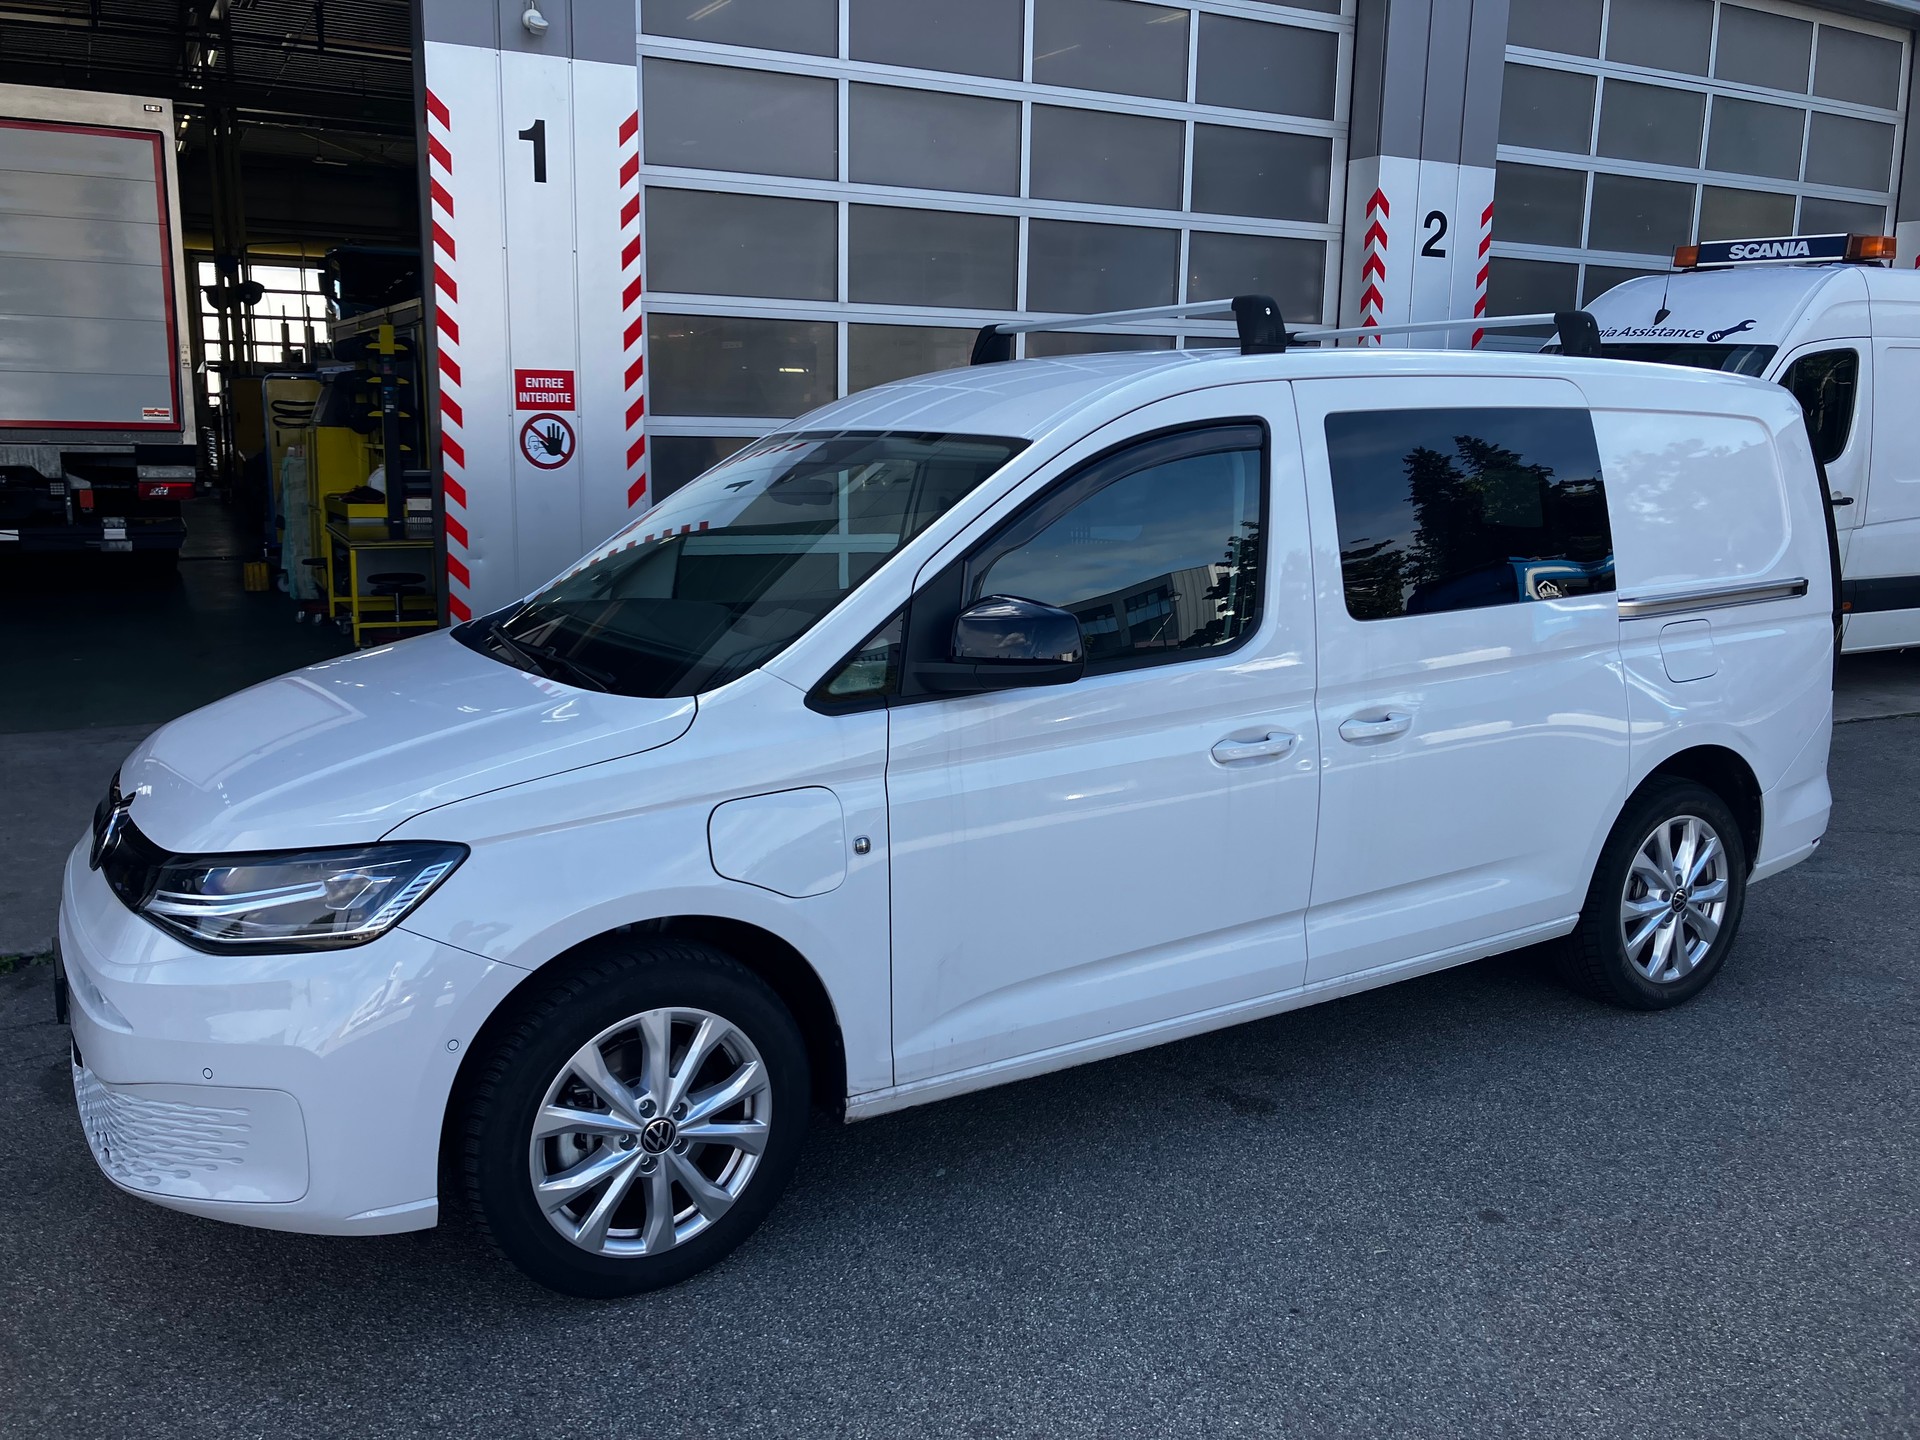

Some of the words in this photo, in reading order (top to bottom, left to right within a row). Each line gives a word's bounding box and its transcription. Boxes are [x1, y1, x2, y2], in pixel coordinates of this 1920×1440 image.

[518, 119, 547, 183] 1
[1421, 210, 1448, 258] 2
[1728, 241, 1810, 260] SCANIA
[1617, 326, 1705, 339] Assistance
[525, 377, 564, 389] ENTREE
[519, 391, 571, 404] INTERDITE
